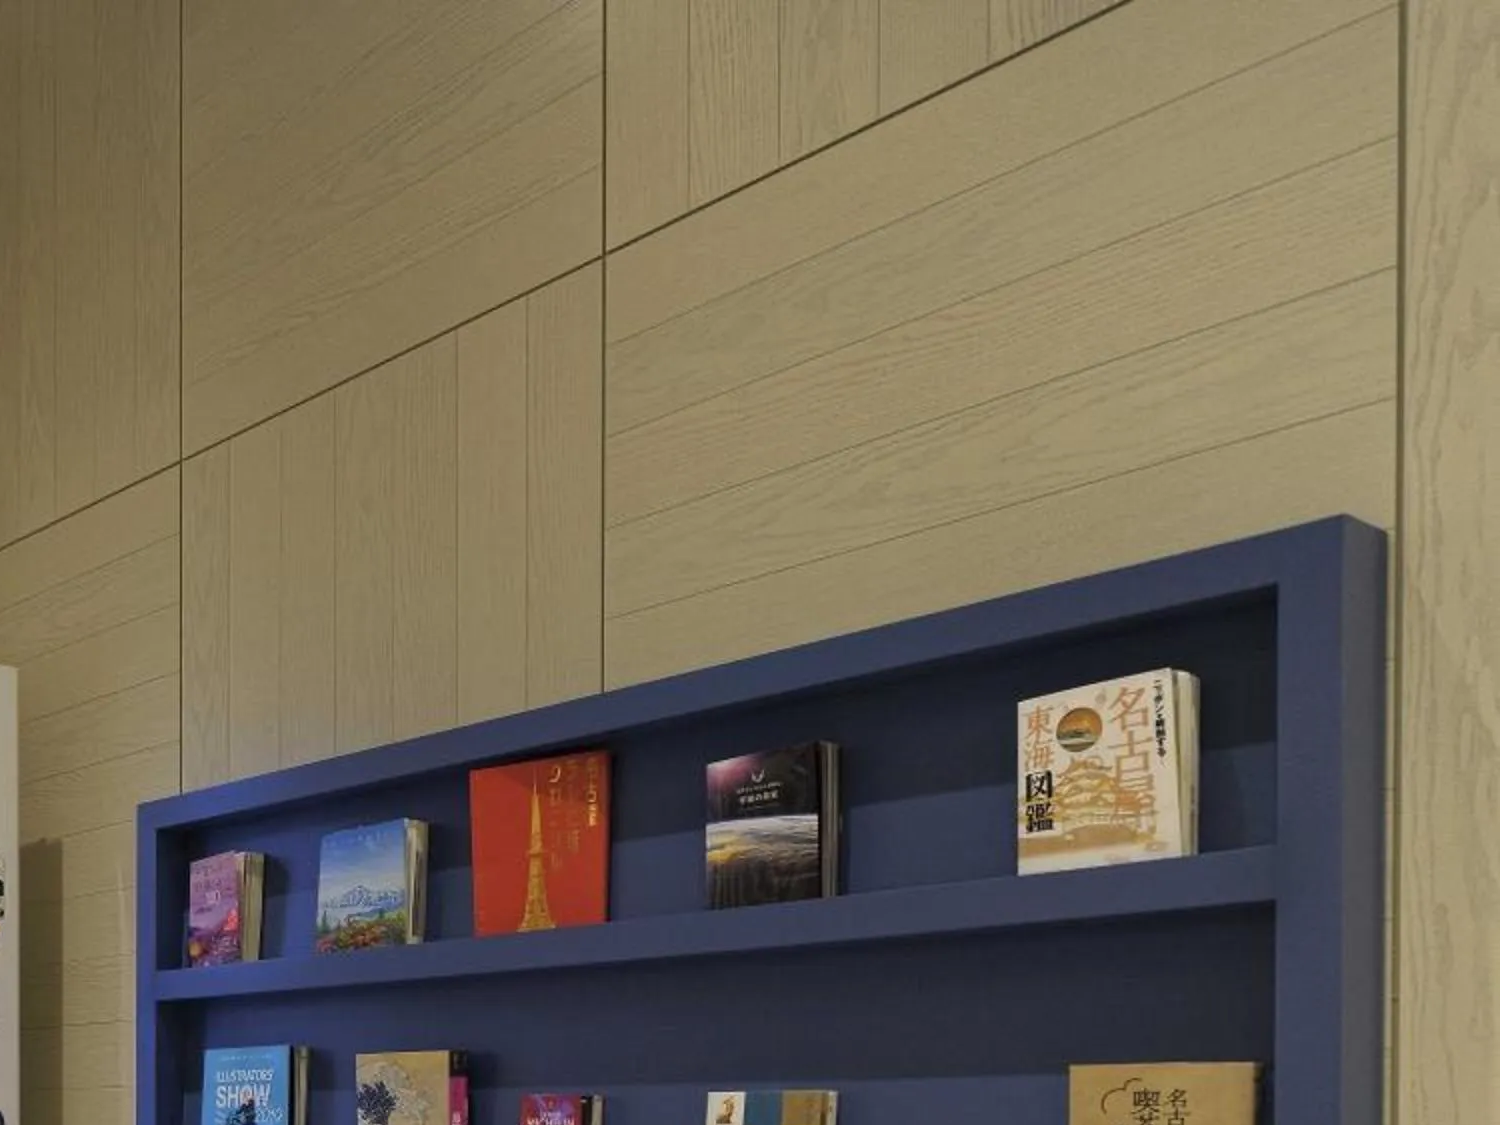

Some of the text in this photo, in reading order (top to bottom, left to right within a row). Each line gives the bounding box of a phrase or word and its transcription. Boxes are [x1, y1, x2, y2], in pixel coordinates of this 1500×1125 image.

[1107, 685, 1158, 840] 名古屋
[216, 1083, 271, 1109] SHOW
